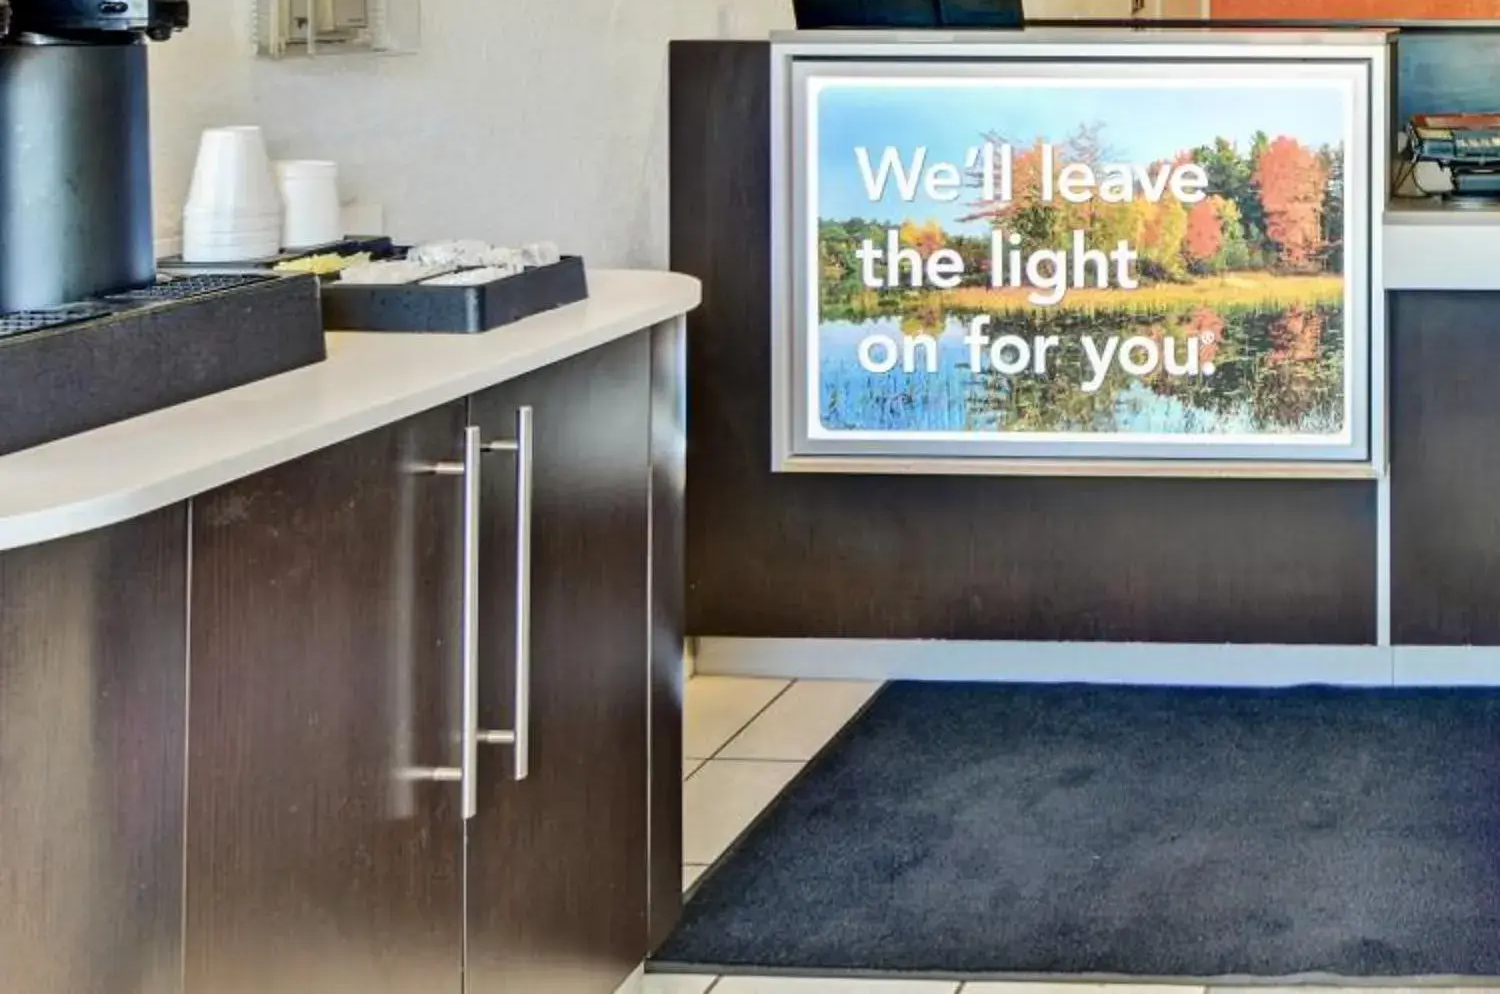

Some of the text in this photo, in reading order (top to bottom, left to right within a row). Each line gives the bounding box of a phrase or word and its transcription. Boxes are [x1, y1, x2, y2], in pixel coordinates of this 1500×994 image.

[854, 142, 1209, 203] We'll leave
[855, 229, 1138, 305] the light
[857, 333, 938, 375] on
[964, 316, 1059, 375] for
